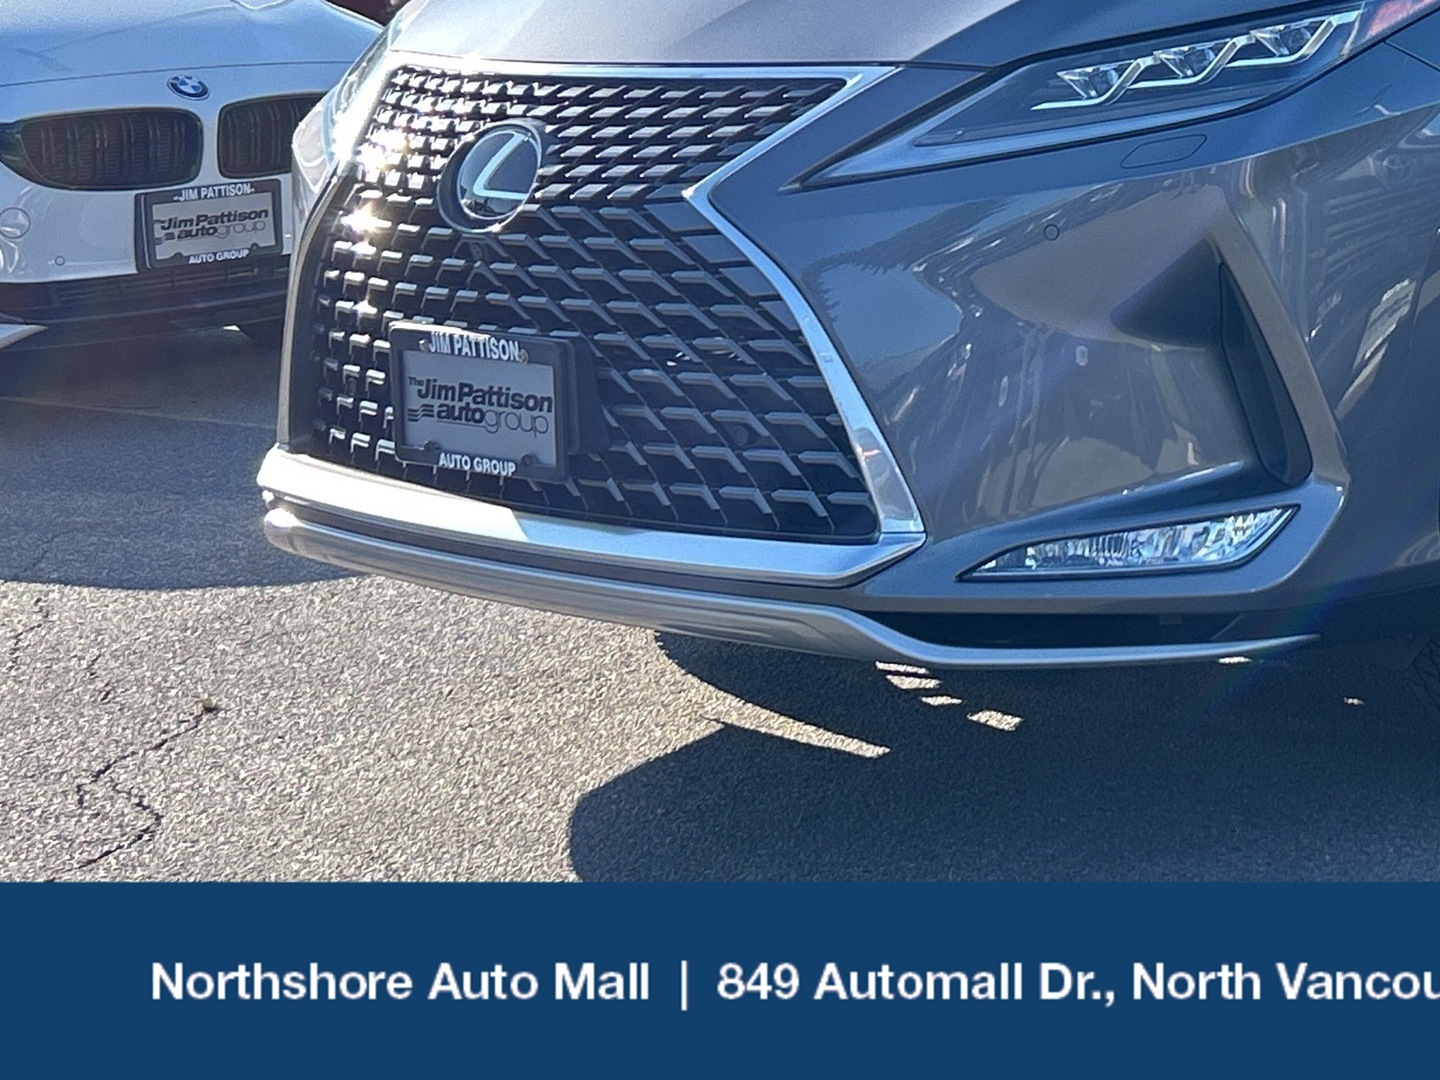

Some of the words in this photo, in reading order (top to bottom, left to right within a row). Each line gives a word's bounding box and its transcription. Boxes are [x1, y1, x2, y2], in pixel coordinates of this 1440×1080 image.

[180, 188, 198, 202] JIM
[201, 183, 251, 200] PATTISON
[188, 253, 214, 265] AUTO
[216, 248, 249, 261] GROUP
[428, 331, 451, 354] JIM
[453, 332, 521, 362] PATTISON
[408, 376, 424, 387] The
[438, 452, 472, 471] AUTO
[473, 457, 516, 477] GROUP
